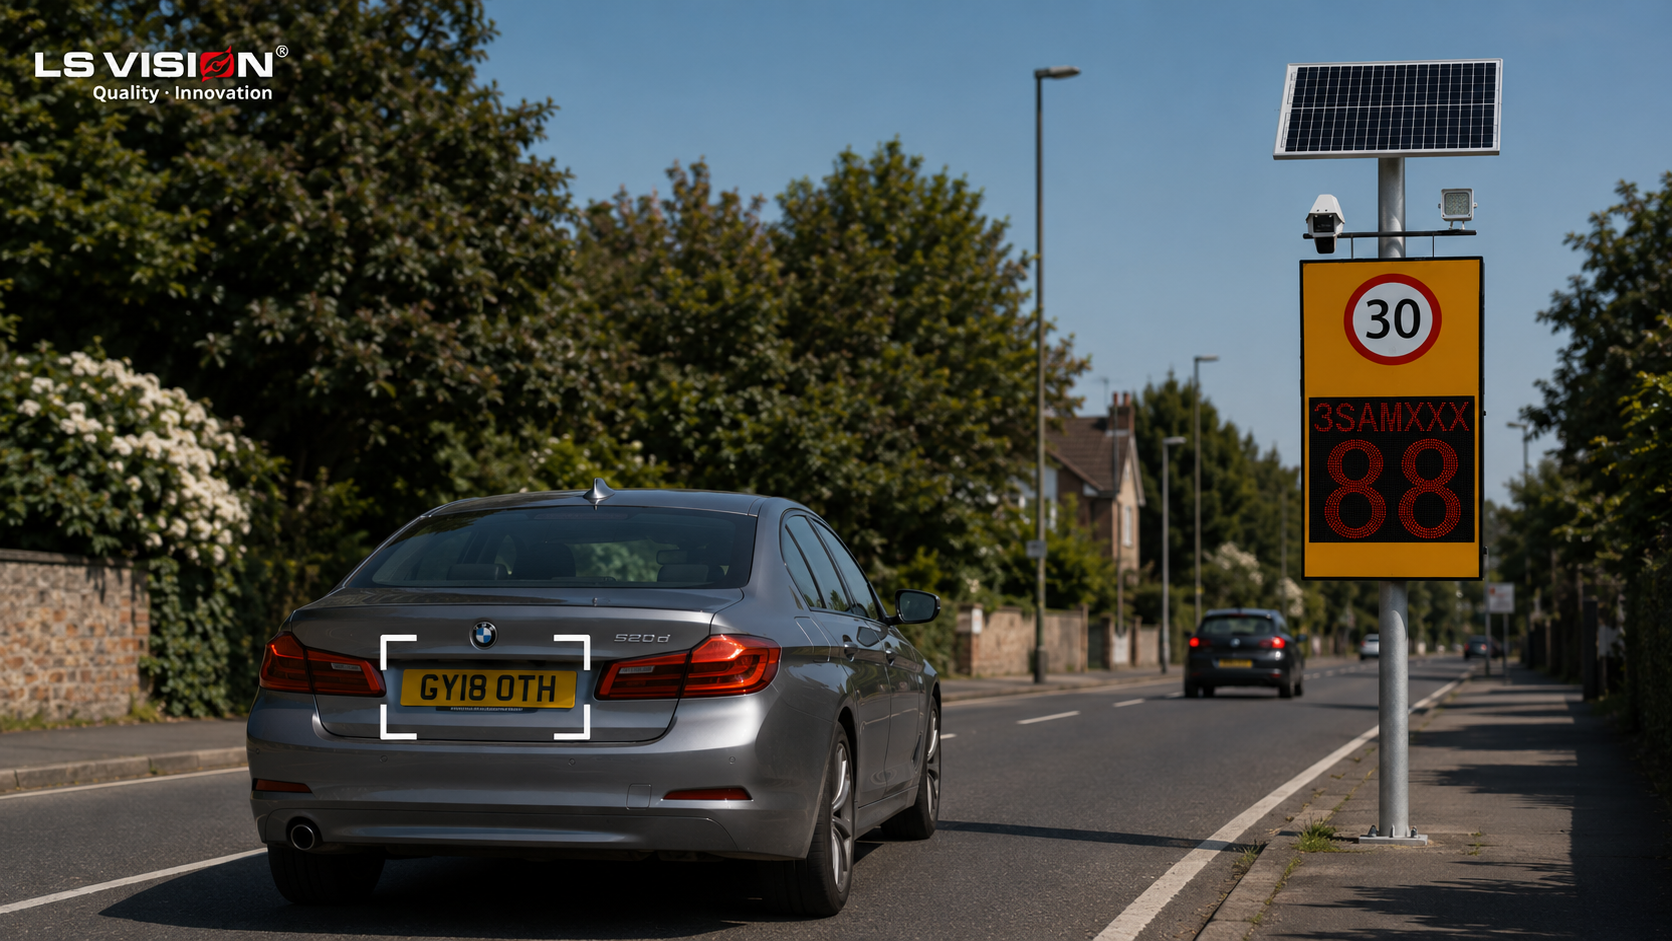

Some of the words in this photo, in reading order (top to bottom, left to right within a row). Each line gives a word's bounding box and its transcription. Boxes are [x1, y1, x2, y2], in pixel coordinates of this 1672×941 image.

[1366, 299, 1421, 339] 30
[1314, 402, 1469, 432] 3SAMXXX
[1324, 438, 1461, 539] 88
[613, 633, 670, 643] 520d
[420, 674, 487, 702] GY18
[496, 675, 556, 702] OTH
